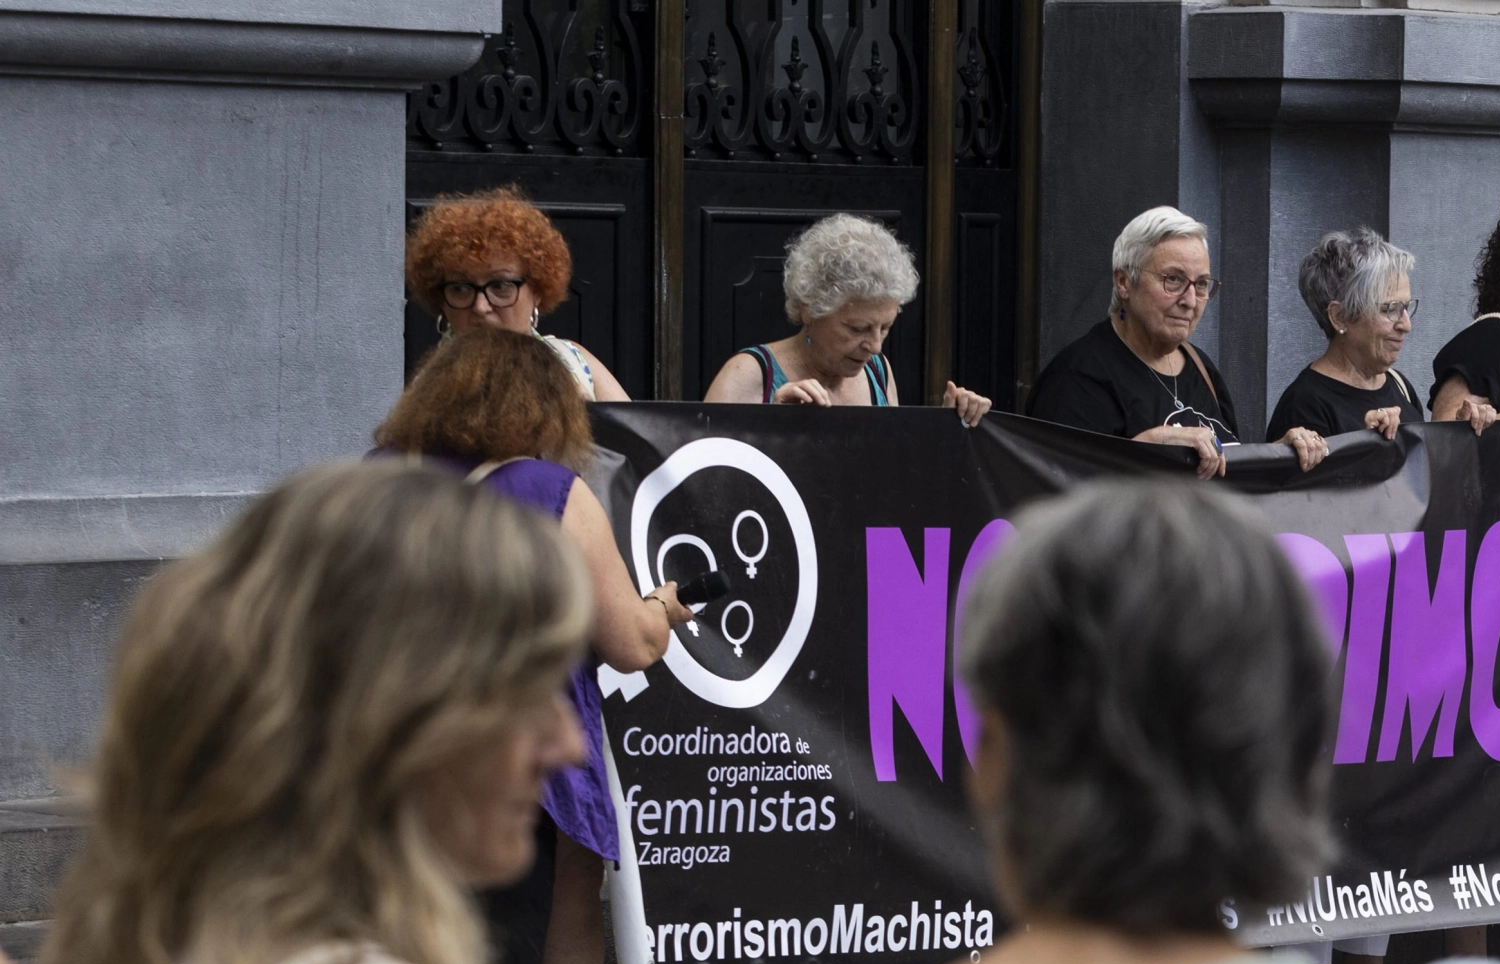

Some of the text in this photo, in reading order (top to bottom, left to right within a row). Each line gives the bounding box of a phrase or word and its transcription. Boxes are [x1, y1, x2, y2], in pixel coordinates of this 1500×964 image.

[865, 518, 1020, 783] N
[622, 725, 811, 756] Coordinadora de
[706, 760, 833, 788] organizaciones
[625, 784, 836, 836] feministas
[638, 841, 731, 870] Zaragoza
